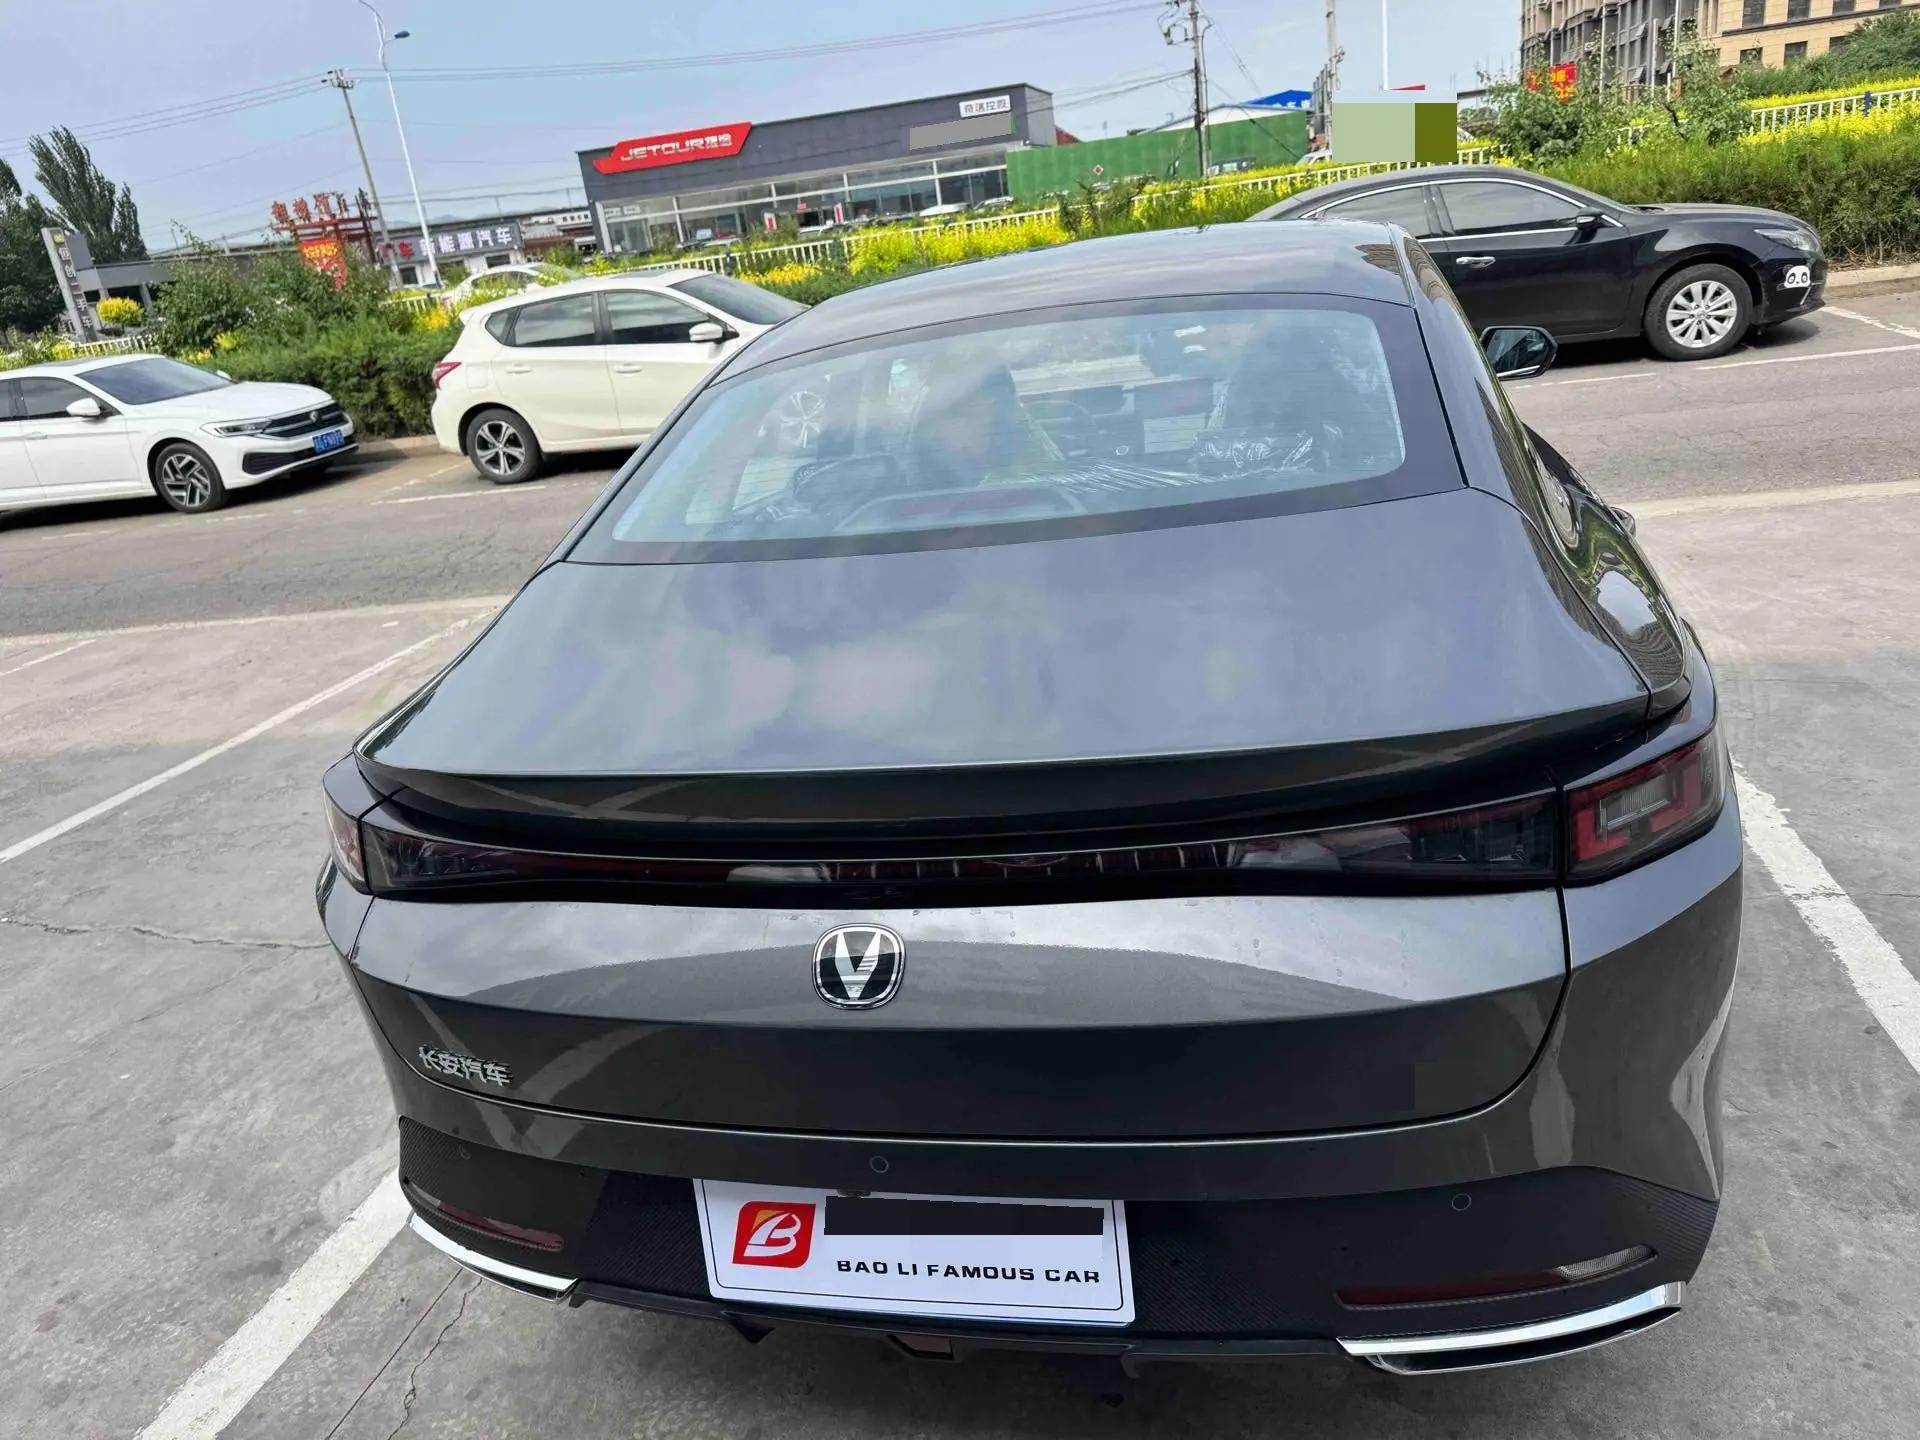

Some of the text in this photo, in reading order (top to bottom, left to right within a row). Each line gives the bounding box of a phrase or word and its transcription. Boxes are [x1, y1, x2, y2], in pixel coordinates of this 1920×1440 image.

[419, 1045, 510, 1086] 长安汽车
[837, 1260, 1100, 1283] BAO LI FAMOUS CAR
